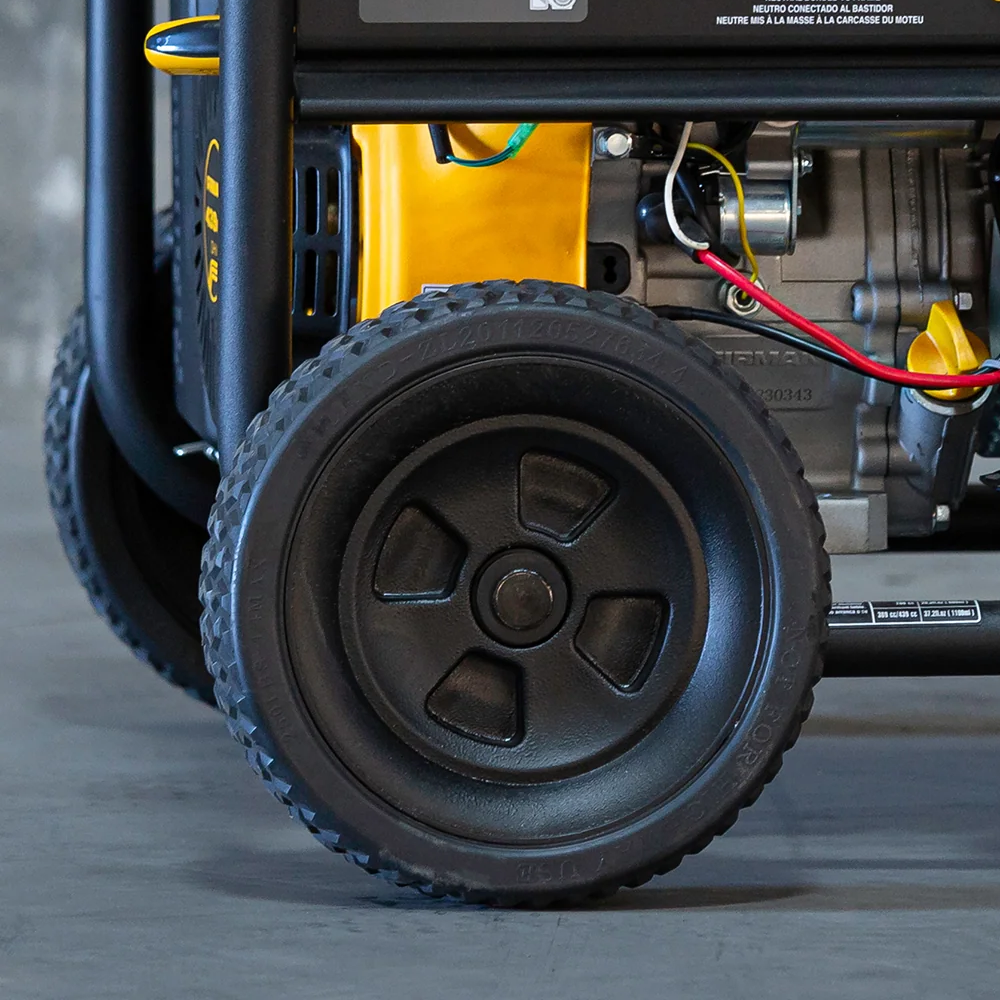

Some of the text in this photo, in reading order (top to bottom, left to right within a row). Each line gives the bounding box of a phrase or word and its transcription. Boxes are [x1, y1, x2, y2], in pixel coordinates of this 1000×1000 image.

[753, 4, 893, 13] NEUTRO CONECTADO AL BASTIDOR
[717, 16, 748, 25] NEUTRE
[751, 16, 764, 24] MIS
[775, 16, 784, 24] LA
[787, 16, 814, 24] MASSE
[824, 16, 834, 24] LA
[836, 16, 880, 24] CARCASSE
[882, 16, 893, 24] DU
[895, 16, 924, 24] MOTEU
